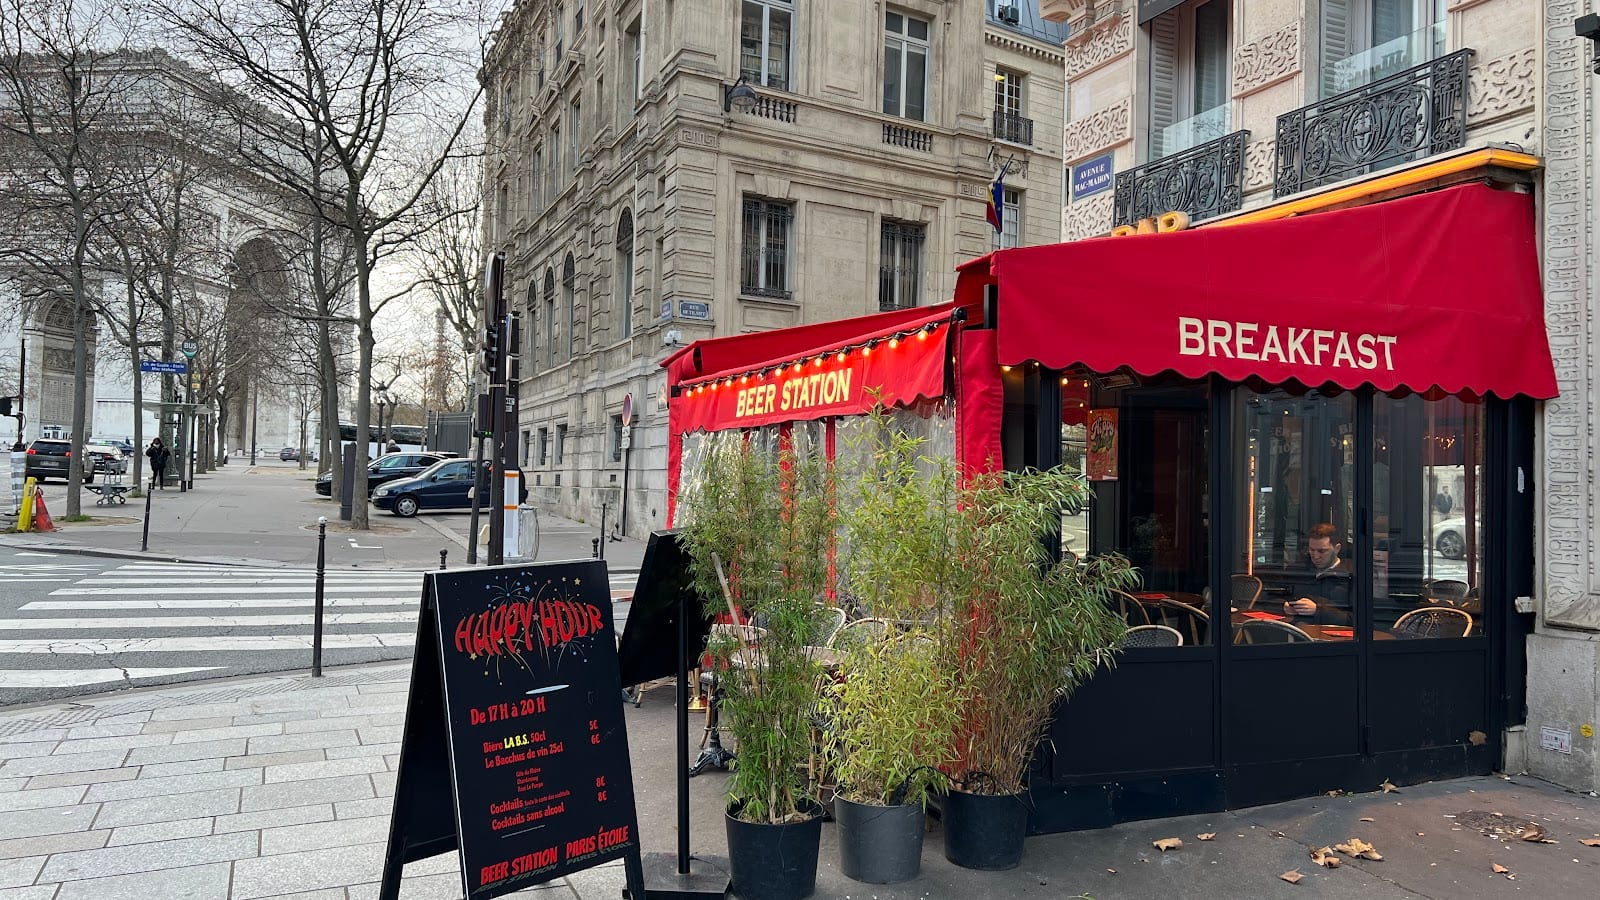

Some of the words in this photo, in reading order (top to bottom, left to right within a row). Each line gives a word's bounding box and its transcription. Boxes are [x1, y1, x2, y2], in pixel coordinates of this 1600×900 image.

[1080, 163, 1105, 180] AVENUE
[1074, 173, 1110, 193] MAC-MAHON
[1178, 316, 1397, 370] BREAKFAST
[736, 384, 776, 417] BEER
[780, 368, 852, 411] STATION
[455, 599, 533, 656] HAPPY
[539, 600, 604, 647] HOUR
[470, 708, 486, 726] De
[488, 705, 498, 722] 17
[500, 703, 509, 720] H
[511, 703, 519, 718] à
[520, 699, 534, 716] 20
[537, 696, 546, 713] H
[589, 719, 599, 730] 5€
[483, 741, 503, 753] Bière
[504, 736, 515, 749] LA
[530, 731, 546, 744] 50cl
[591, 733, 601, 745] 6€
[485, 758, 494, 769] Le
[495, 752, 526, 767] Bacchus
[527, 748, 536, 760] de
[536, 745, 548, 757] vin
[549, 742, 564, 755] 25cl
[596, 776, 606, 788] 8€
[490, 797, 523, 815] Cocktails
[597, 790, 607, 802] 8€
[491, 812, 525, 831] Cocktails
[527, 810, 543, 822] sans
[544, 801, 565, 817] alcool
[480, 860, 509, 886] BEER
[511, 845, 558, 876] STATION
[566, 834, 596, 860] PARIS
[597, 825, 629, 849] ÉTOILE
